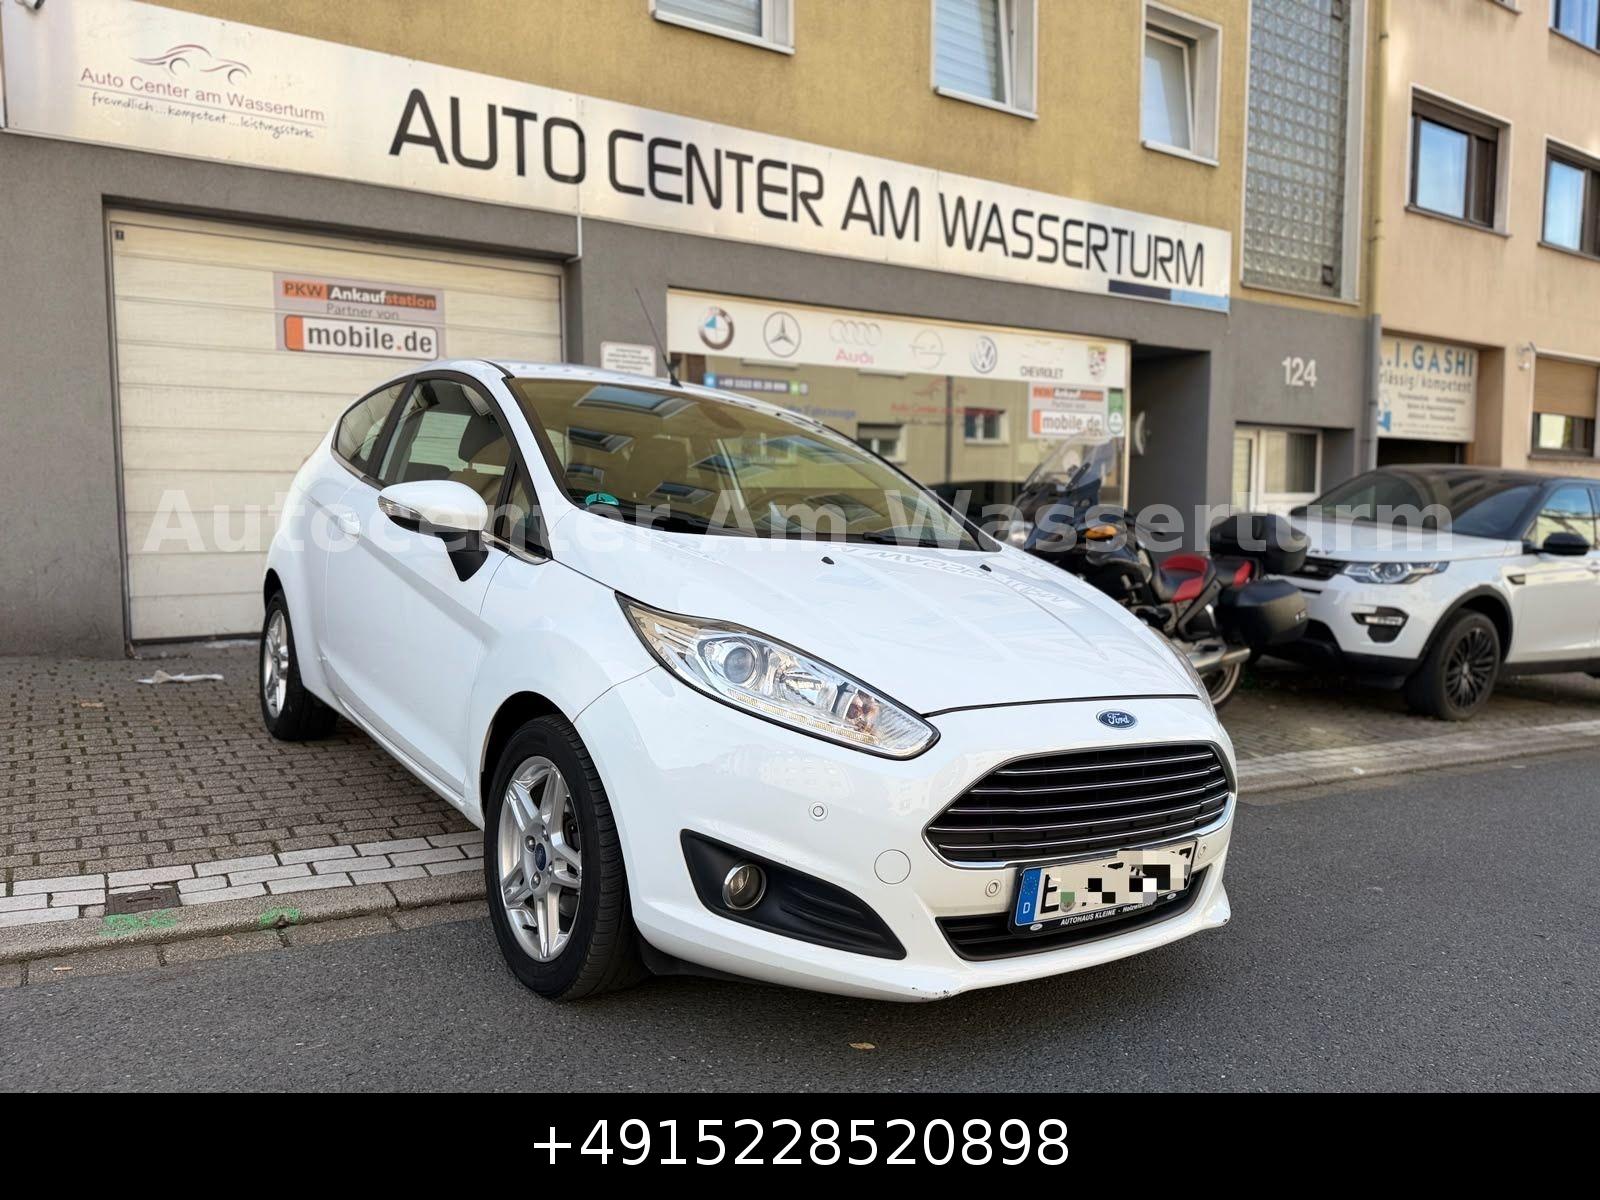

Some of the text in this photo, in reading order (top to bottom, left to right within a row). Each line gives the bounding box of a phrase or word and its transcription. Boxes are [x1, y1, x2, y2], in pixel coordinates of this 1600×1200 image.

[80, 67, 325, 121] Auto Center am Wasserturm
[389, 88, 1204, 288] AUTO CENTER AM WASSERTURM
[284, 282, 324, 297] PKW
[326, 303, 400, 321] Partner von
[307, 325, 433, 353] mobile.de
[835, 349, 875, 365] Audi
[1020, 366, 1064, 380] CHEVROLET
[1282, 356, 1318, 388] 124
[1107, 712, 1130, 725] Ford
[1022, 902, 1031, 914] D
[1060, 912, 1094, 926] AUTOHAUS
[1094, 908, 1117, 919] KLEINE
